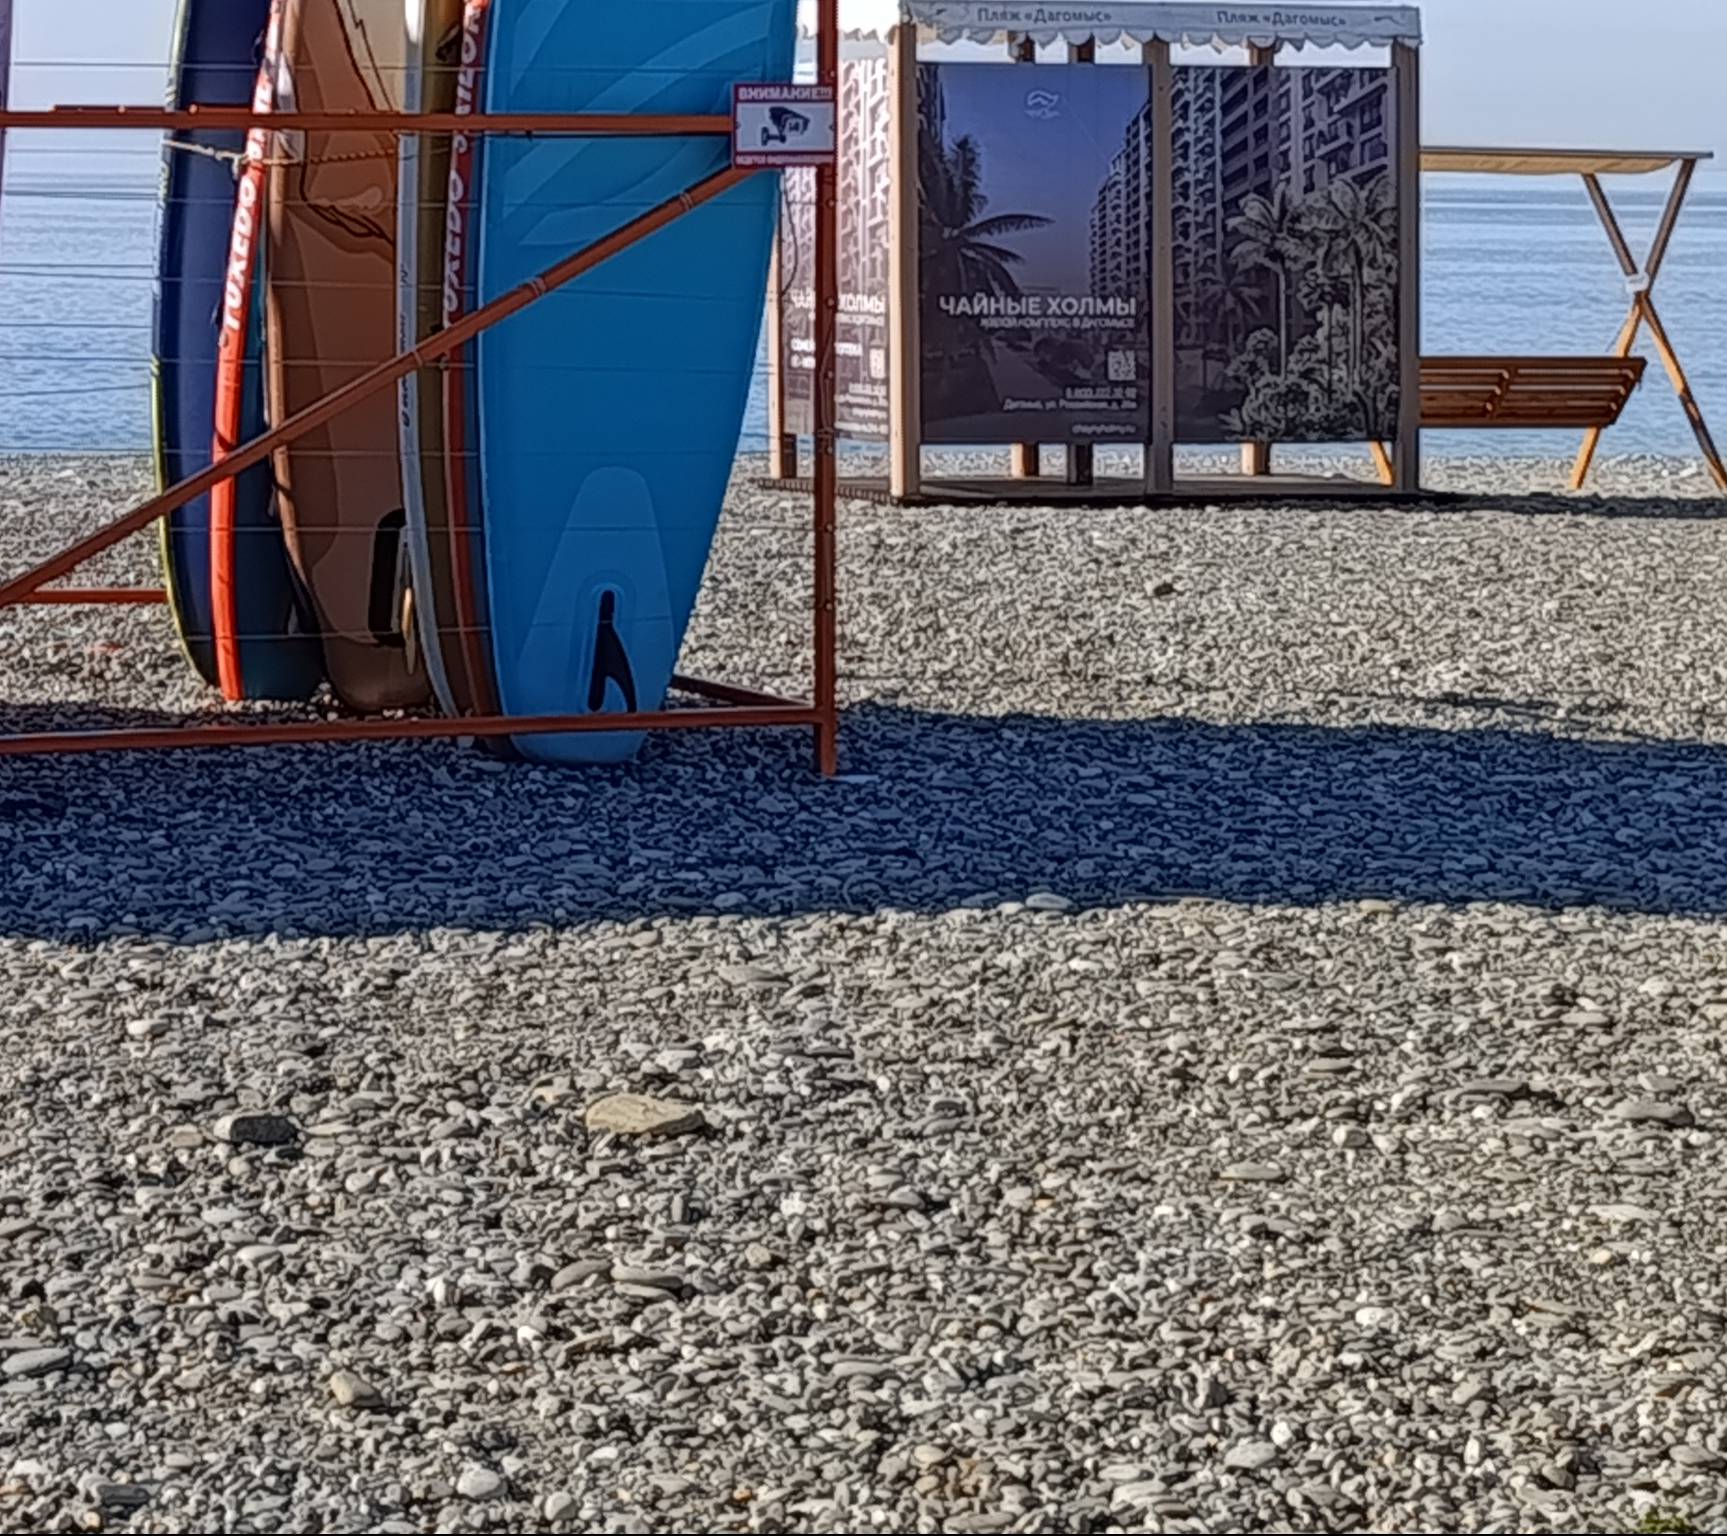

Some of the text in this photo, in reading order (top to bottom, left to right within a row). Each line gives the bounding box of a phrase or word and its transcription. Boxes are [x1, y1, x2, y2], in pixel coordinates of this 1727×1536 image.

[977, 6, 1022, 22] Пляж
[1217, 10, 1260, 24] Пляж
[222, 179, 258, 332] TUXEDO
[939, 292, 1136, 315] ЧАЙНЫЕ ХОЛМЫ
